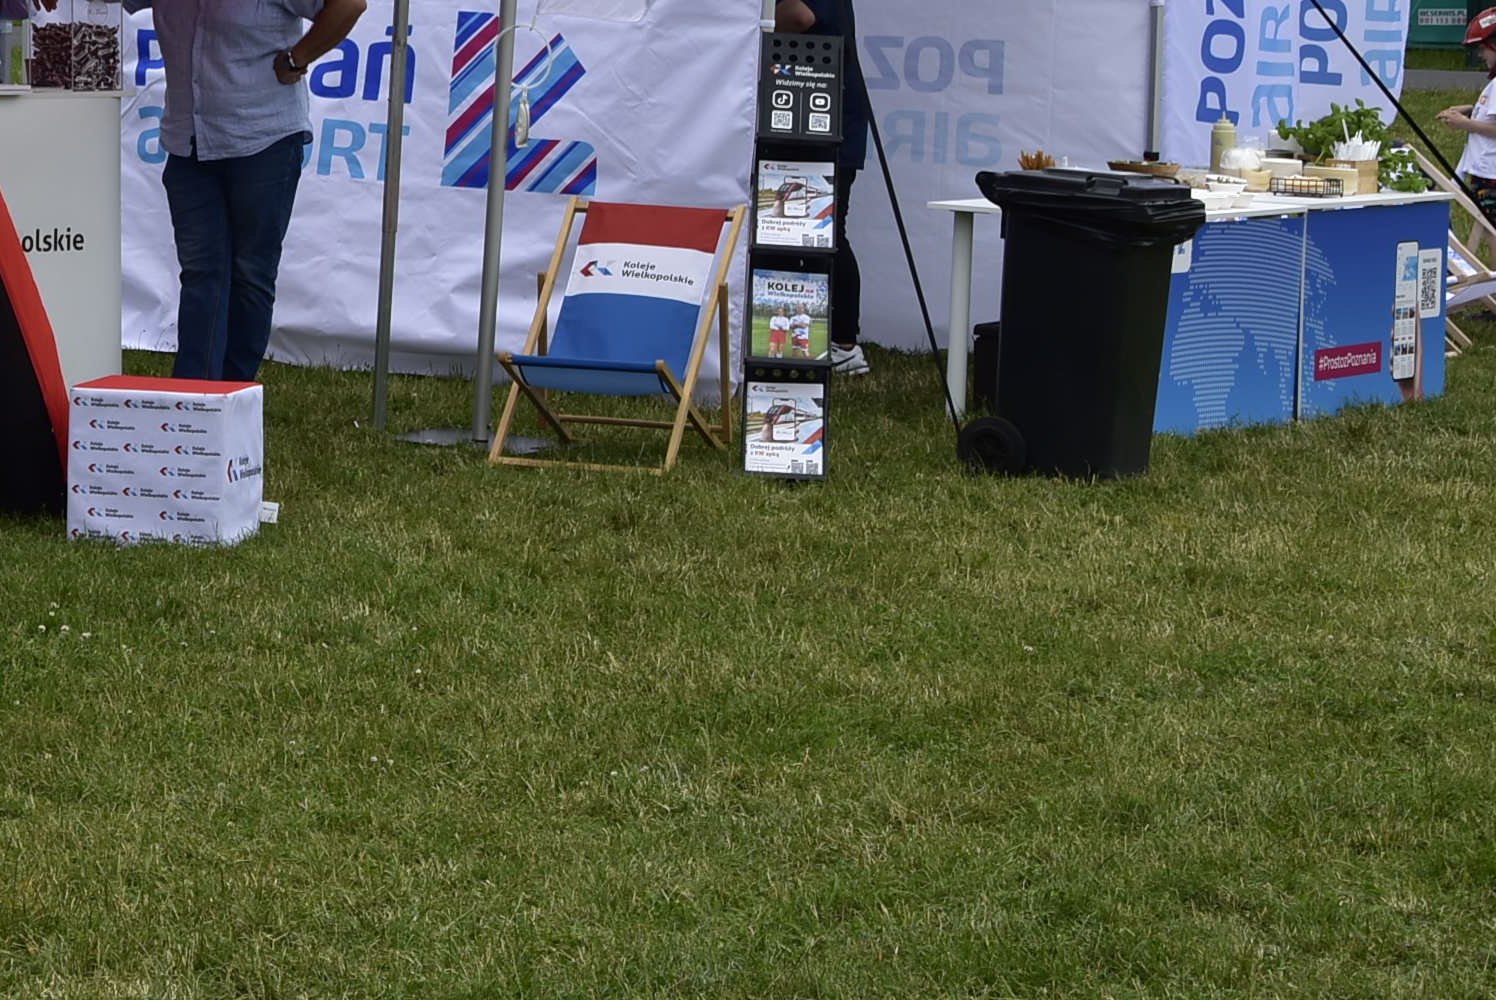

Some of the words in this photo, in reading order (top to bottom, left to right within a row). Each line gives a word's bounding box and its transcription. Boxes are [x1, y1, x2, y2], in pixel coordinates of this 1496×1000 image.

[623, 260, 656, 271] Koleje
[622, 269, 694, 285] Wielkopolskie
[767, 281, 804, 293] KOLEJ
